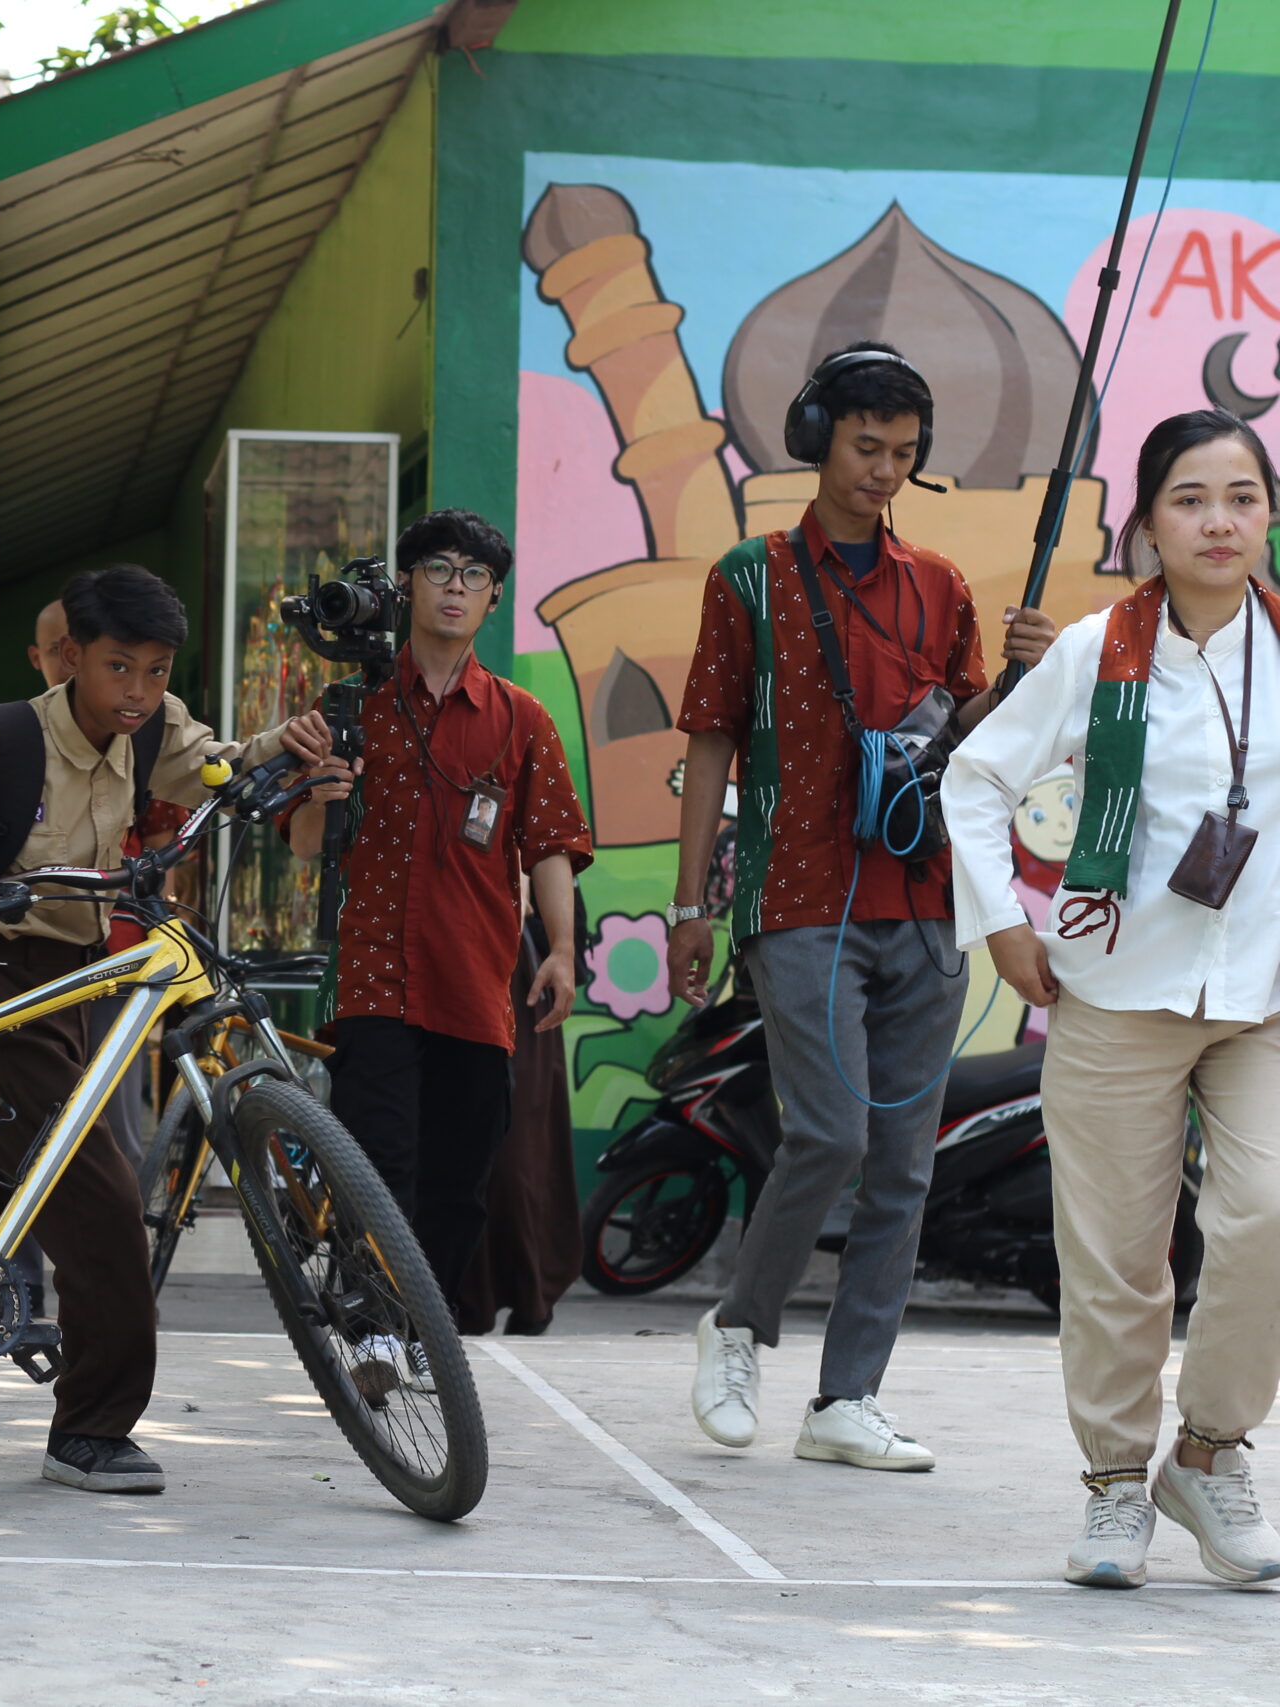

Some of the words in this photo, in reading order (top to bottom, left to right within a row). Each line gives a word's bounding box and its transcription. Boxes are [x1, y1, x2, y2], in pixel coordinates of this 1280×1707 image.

[1149, 229, 1280, 321] AK
[88, 964, 130, 981] HOTROD
[241, 1179, 277, 1241] WIMCYCLE
